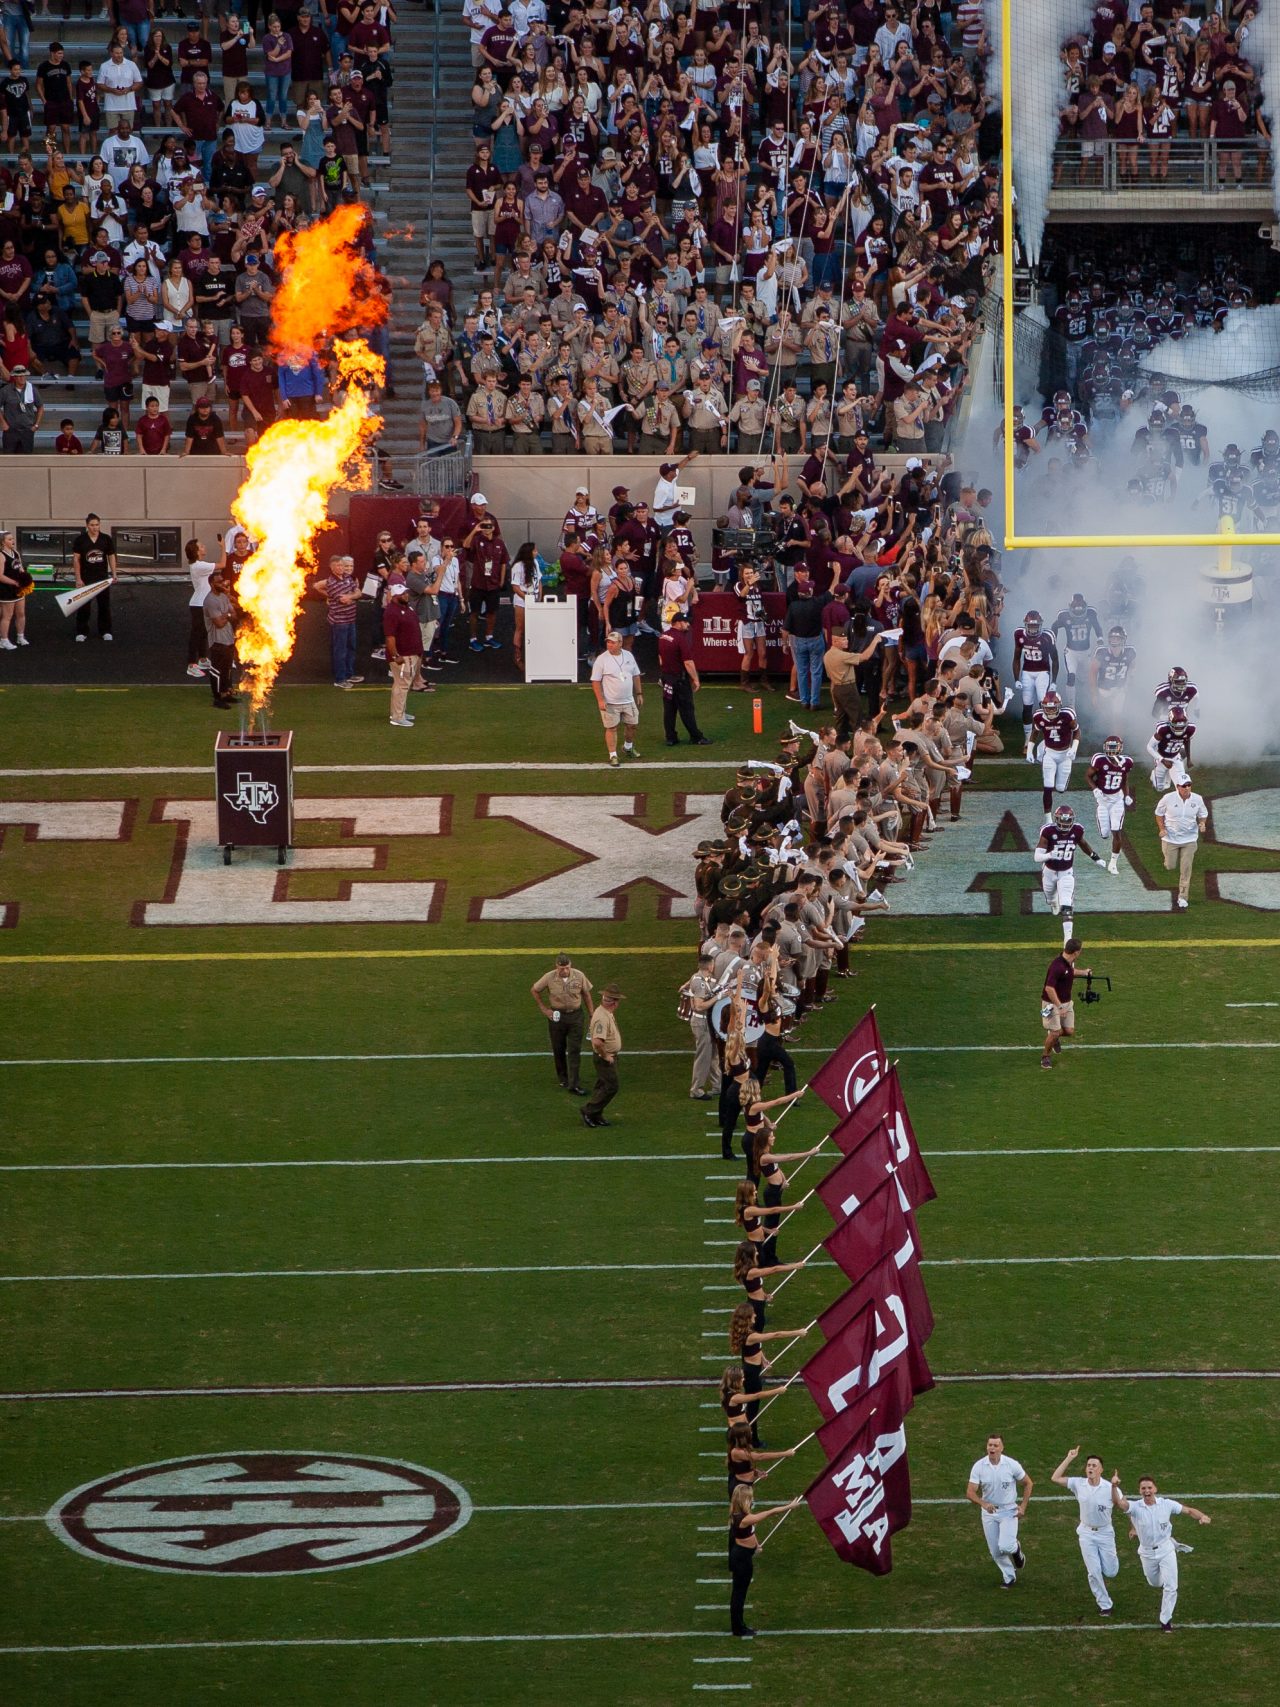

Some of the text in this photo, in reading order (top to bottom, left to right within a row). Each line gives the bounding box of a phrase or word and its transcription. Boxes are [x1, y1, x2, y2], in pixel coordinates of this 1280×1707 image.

[1161, 75, 1179, 97] 12
[659, 160, 673, 174] 12
[547, 266, 561, 283] 12
[1222, 499, 1238, 514] 31
[676, 535, 689, 546] 12
[703, 637, 728, 647] Where
[1104, 666, 1128, 680] 24
[1048, 729, 1061, 742] 4
